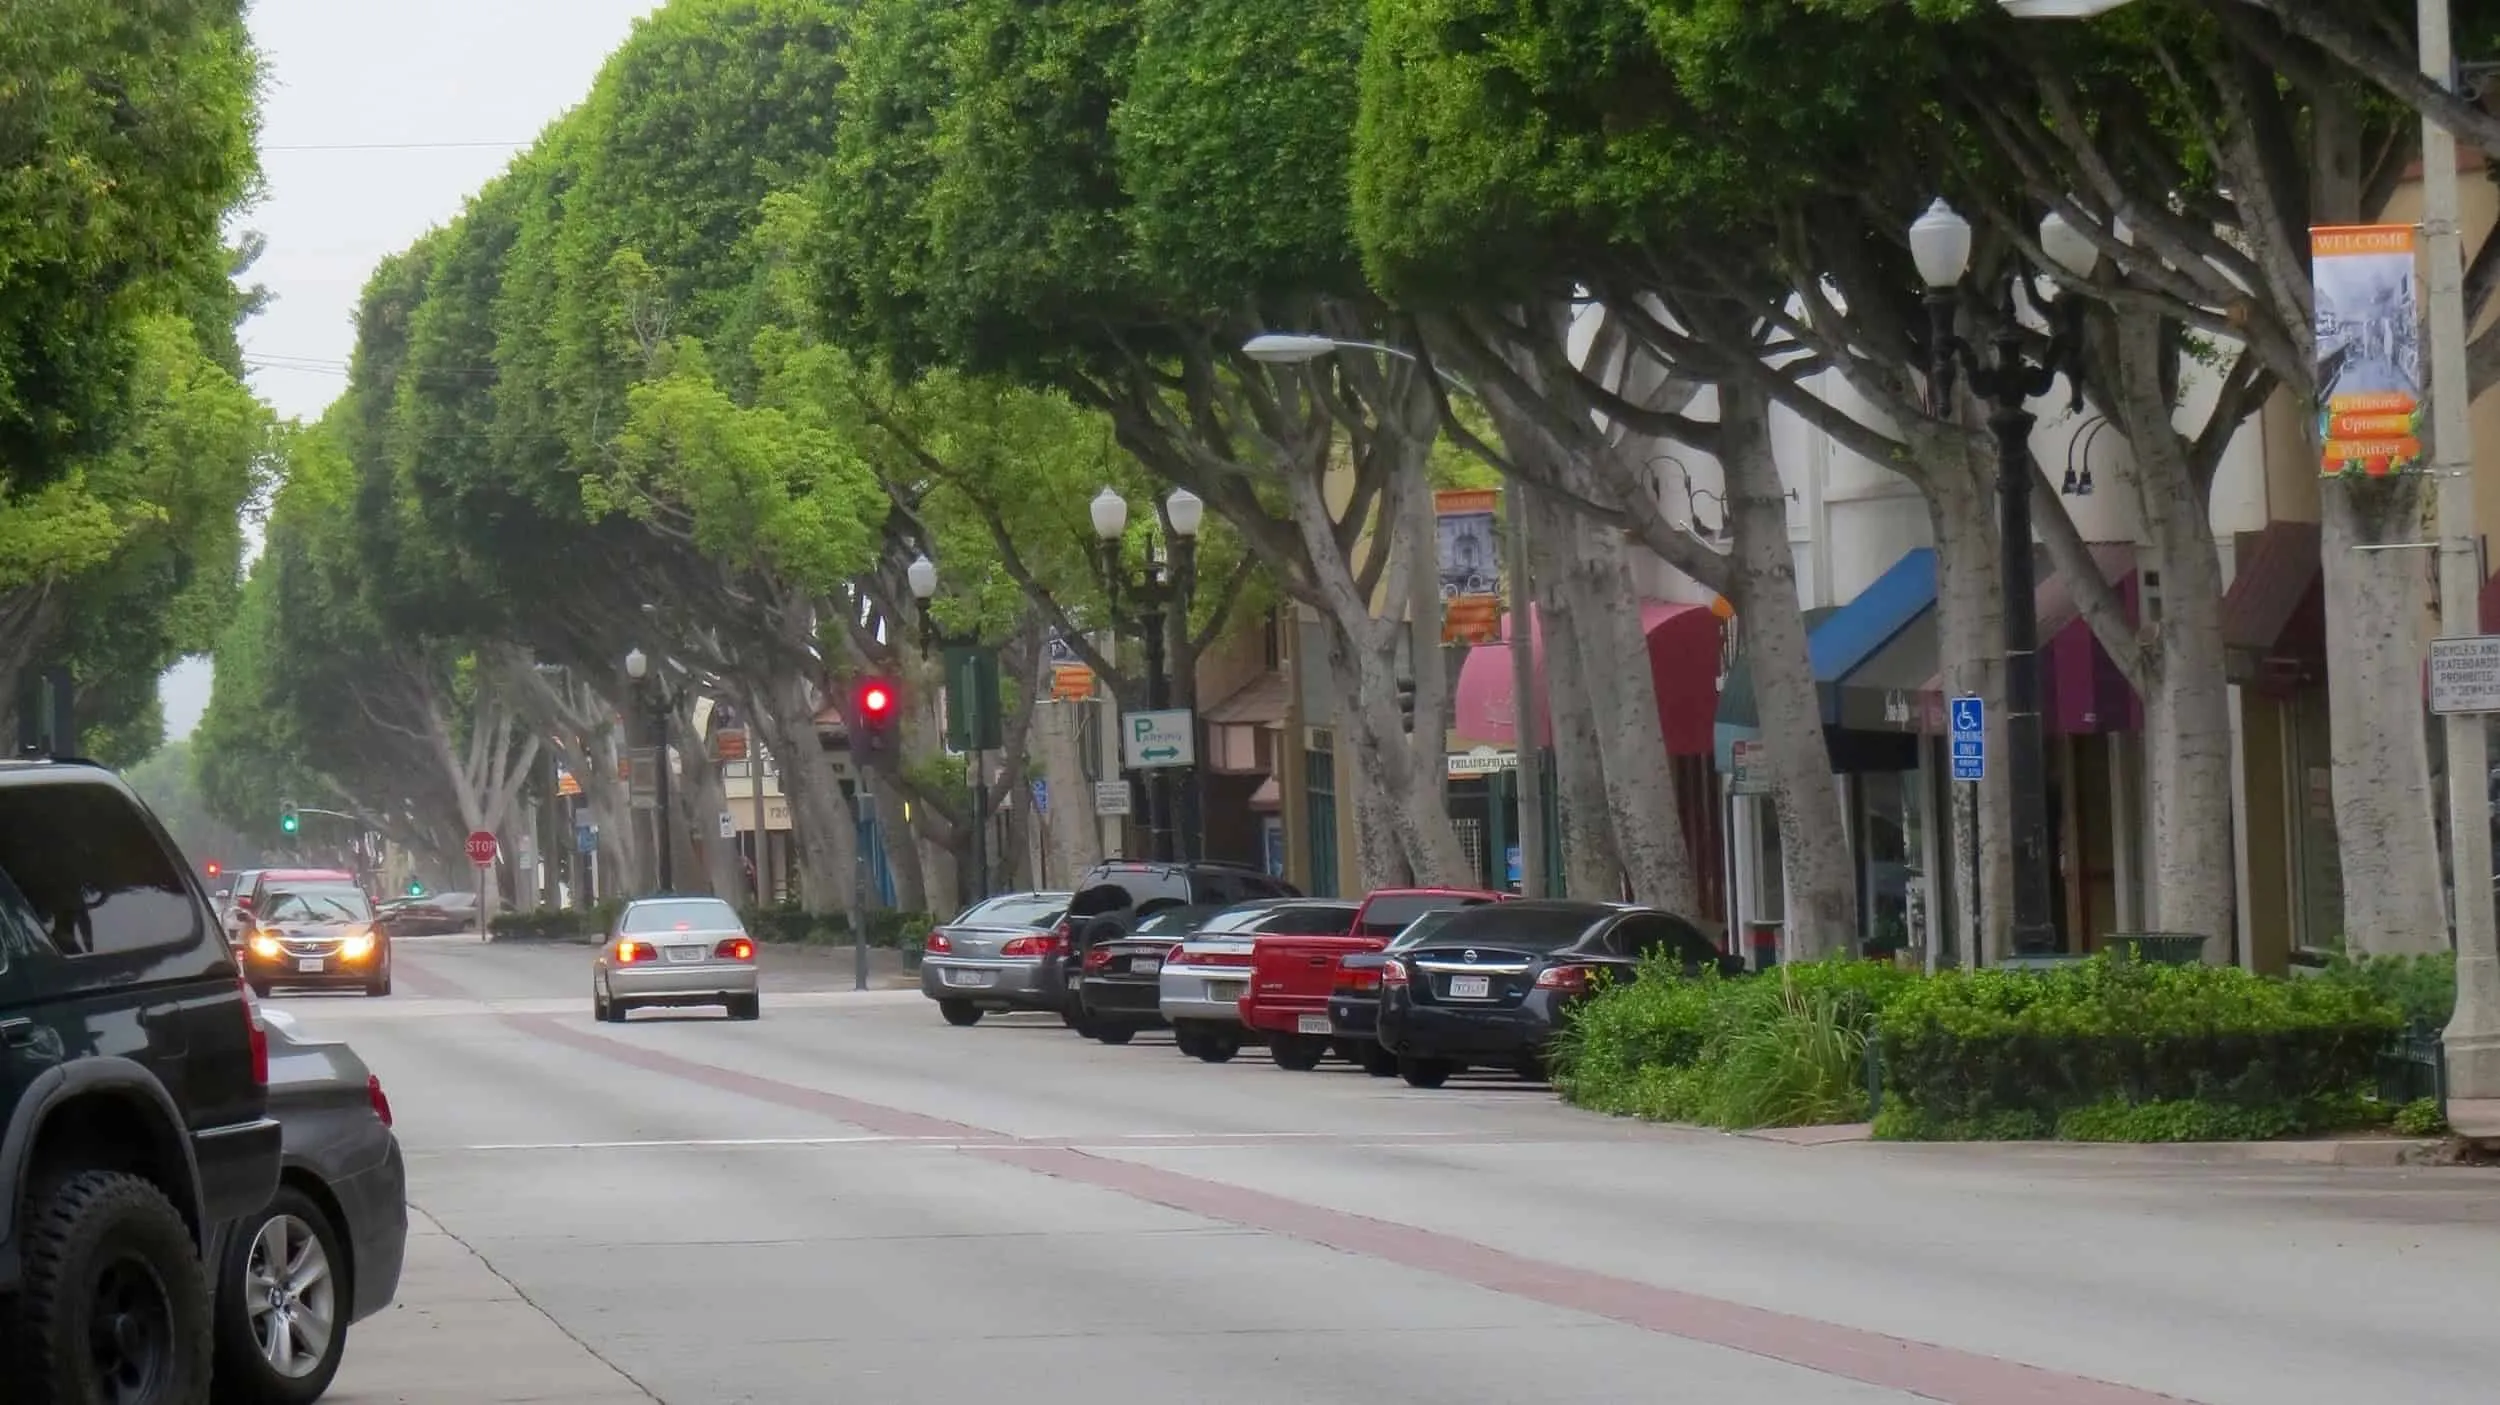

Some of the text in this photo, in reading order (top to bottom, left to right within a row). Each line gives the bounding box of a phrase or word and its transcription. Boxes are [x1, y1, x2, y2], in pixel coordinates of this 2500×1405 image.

[2318, 233, 2407, 248] WELCOME
[2342, 416, 2398, 433] Uptown
[2343, 440, 2401, 456] Whittier
[2433, 643, 2499, 657] BICYCLES AND
[2440, 671, 2495, 683] PROHIBITED
[1134, 719, 1182, 742] PARKING
[1953, 731, 1982, 741] PARKING
[1960, 743, 1976, 755] ONLY
[465, 840, 497, 852] STOP
